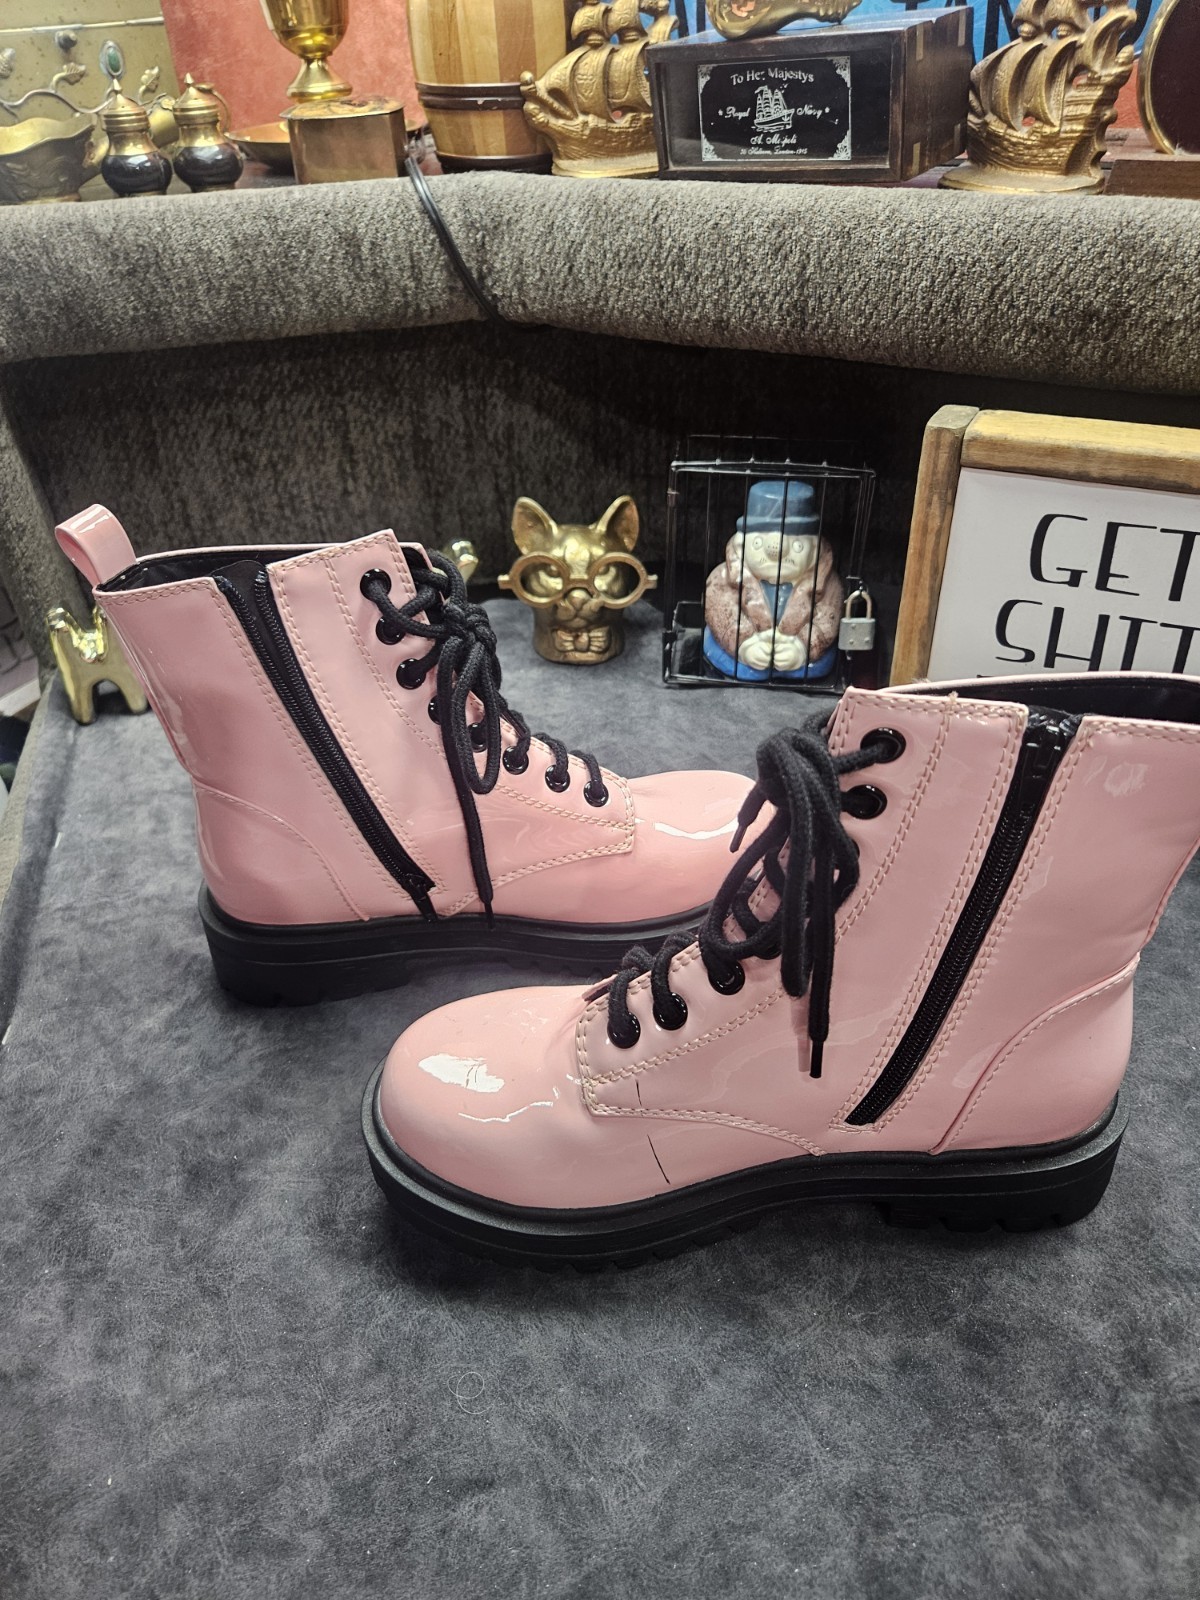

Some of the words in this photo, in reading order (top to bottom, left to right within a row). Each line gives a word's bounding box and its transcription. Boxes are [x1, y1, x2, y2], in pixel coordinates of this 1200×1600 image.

[730, 73, 744, 86] To
[746, 70, 766, 82] Her
[767, 67, 815, 83] Majestys
[724, 106, 751, 120] Royal
[796, 104, 823, 120] Navy
[1029, 513, 1200, 602] GET
[995, 599, 1200, 674] SHIT
